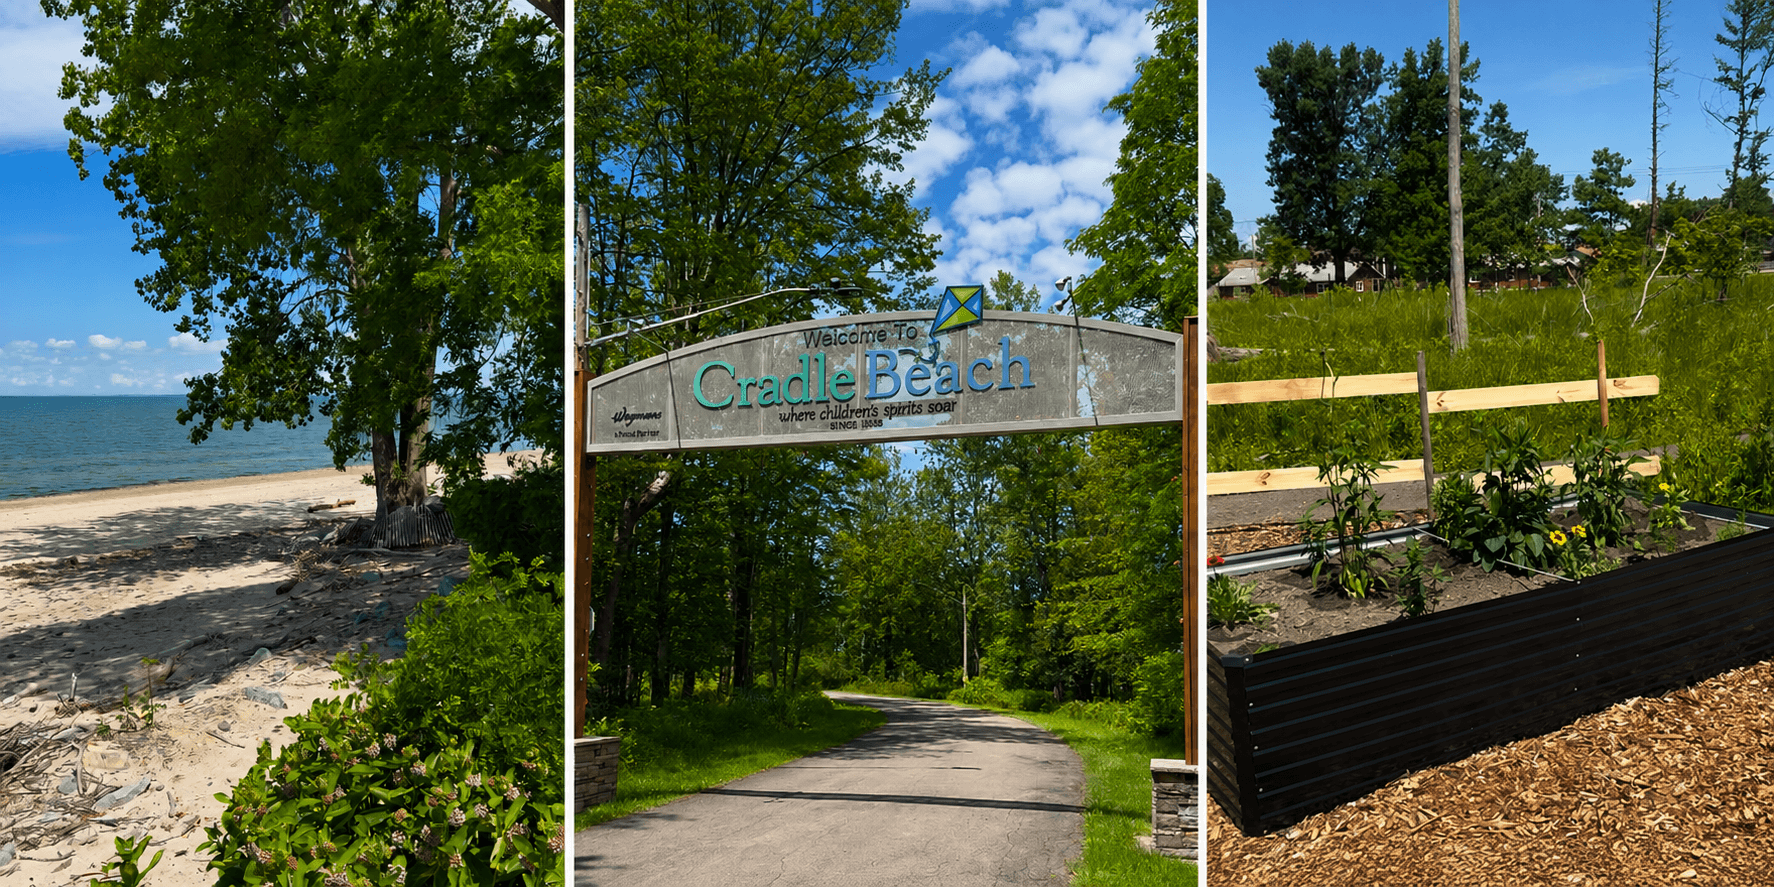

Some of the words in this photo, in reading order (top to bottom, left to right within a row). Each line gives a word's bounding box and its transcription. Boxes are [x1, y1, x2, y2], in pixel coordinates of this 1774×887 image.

[894, 323, 918, 340] To
[693, 352, 856, 410] Cradle
[865, 336, 1036, 399] Beach
[778, 407, 817, 422] where
[819, 404, 879, 420] children's
[927, 401, 957, 413] soar
